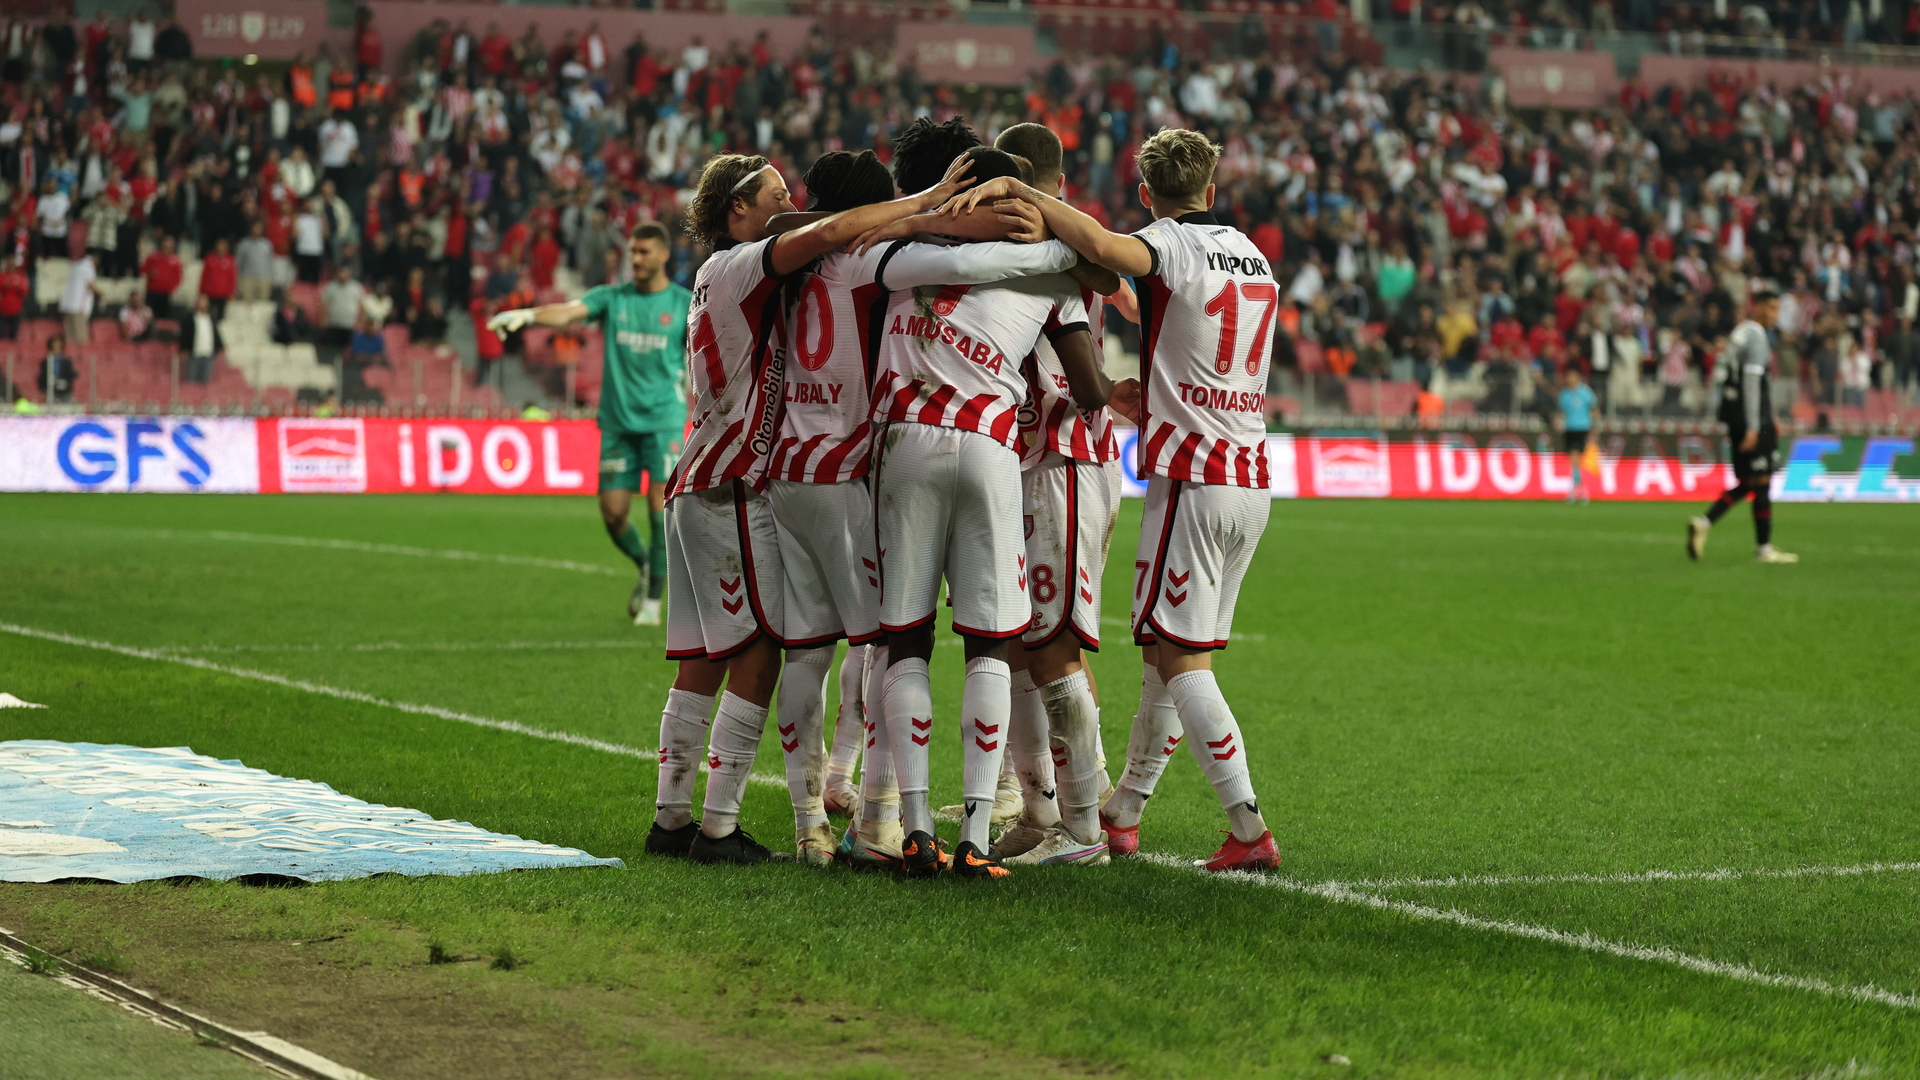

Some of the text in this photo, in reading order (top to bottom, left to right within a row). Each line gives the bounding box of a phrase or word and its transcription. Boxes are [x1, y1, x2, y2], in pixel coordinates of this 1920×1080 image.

[796, 274, 834, 371] 0
[889, 315, 1004, 376] A.MUSABA
[1205, 279, 1278, 376] 17
[751, 348, 787, 456] Otomobilen
[57, 422, 210, 485] GFS
[1030, 563, 1057, 604] 8
